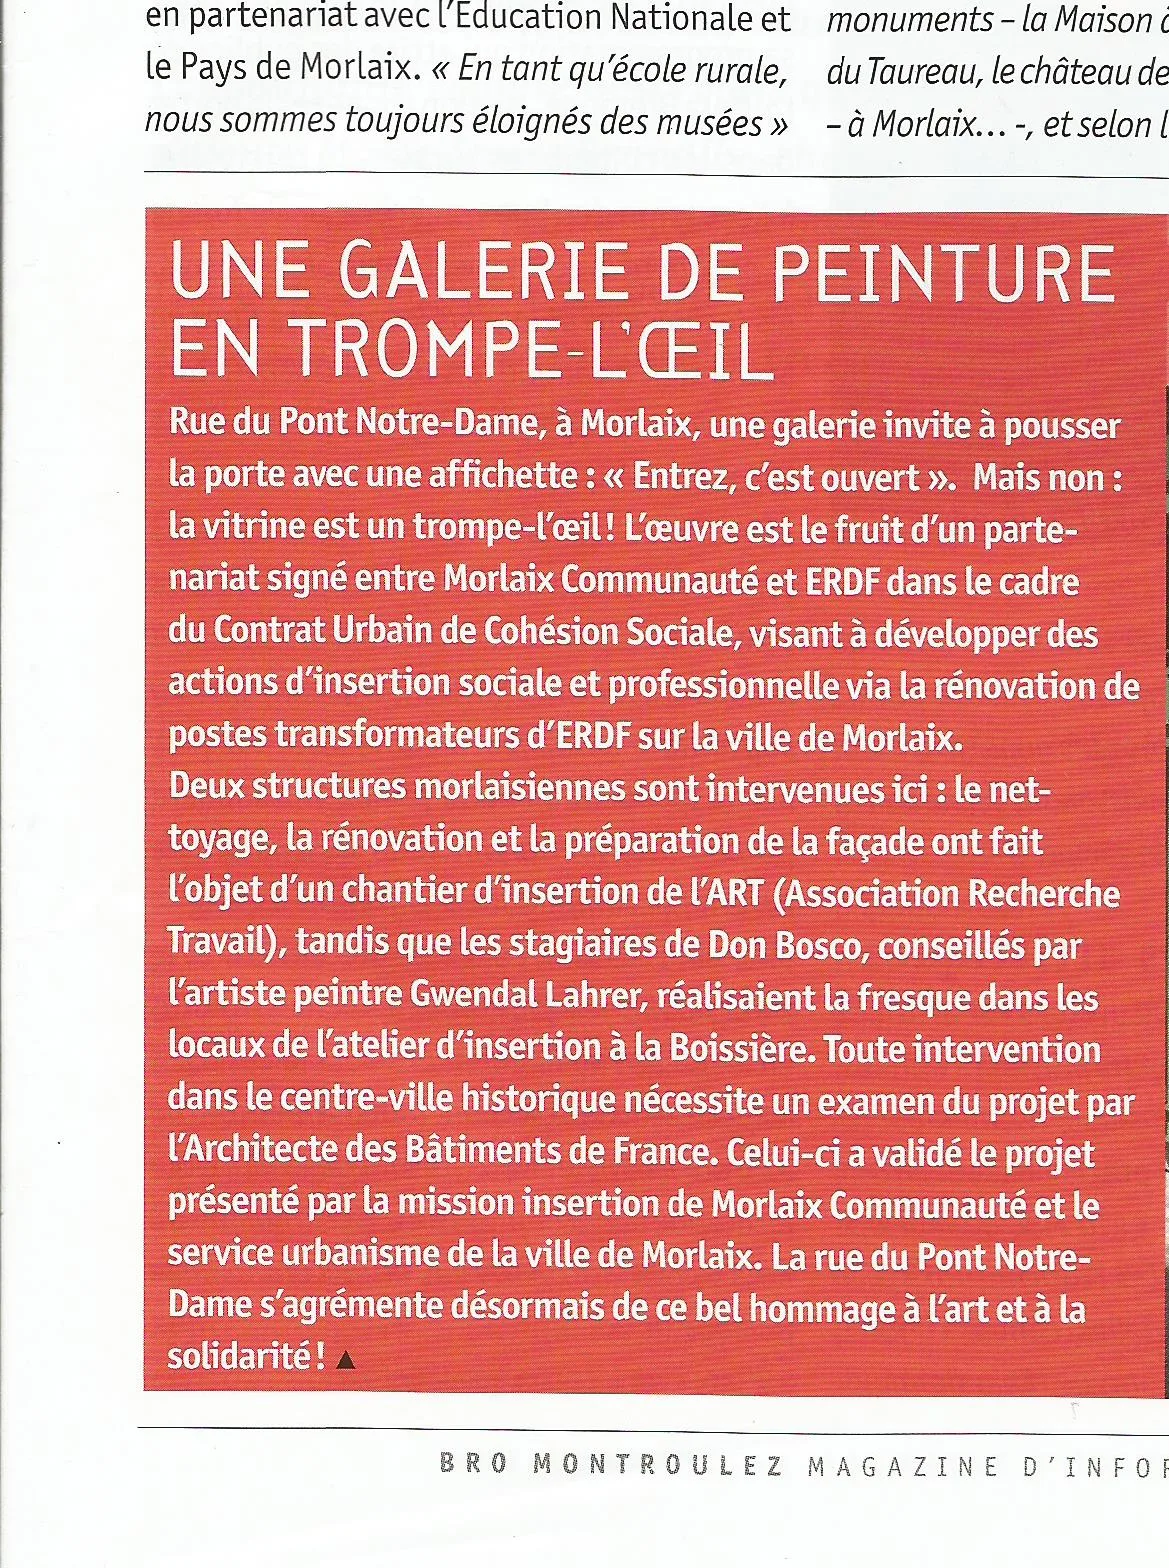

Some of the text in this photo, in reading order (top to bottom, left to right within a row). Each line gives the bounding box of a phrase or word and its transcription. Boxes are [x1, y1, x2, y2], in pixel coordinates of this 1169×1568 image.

[172, 237, 1115, 303] UNE GALERIE DE PEINTURE
[172, 317, 775, 382] EN TROMPE-L'ŒIL
[170, 405, 1122, 447] Rue du Pont Notre-Dame, à Morlaix, une galerie invite à pousser
[169, 559, 1080, 599] nariat signé entre Morlaix Communauté et ERDF dans le cadre
[168, 1027, 1101, 1065] locaux de l'atelier d'insertion à la Boissière. Toute intervention
[440, 1451, 507, 1474] BRO
[533, 1452, 782, 1477] MONTROULEZ
[808, 1456, 997, 1478] MAGAZINE
